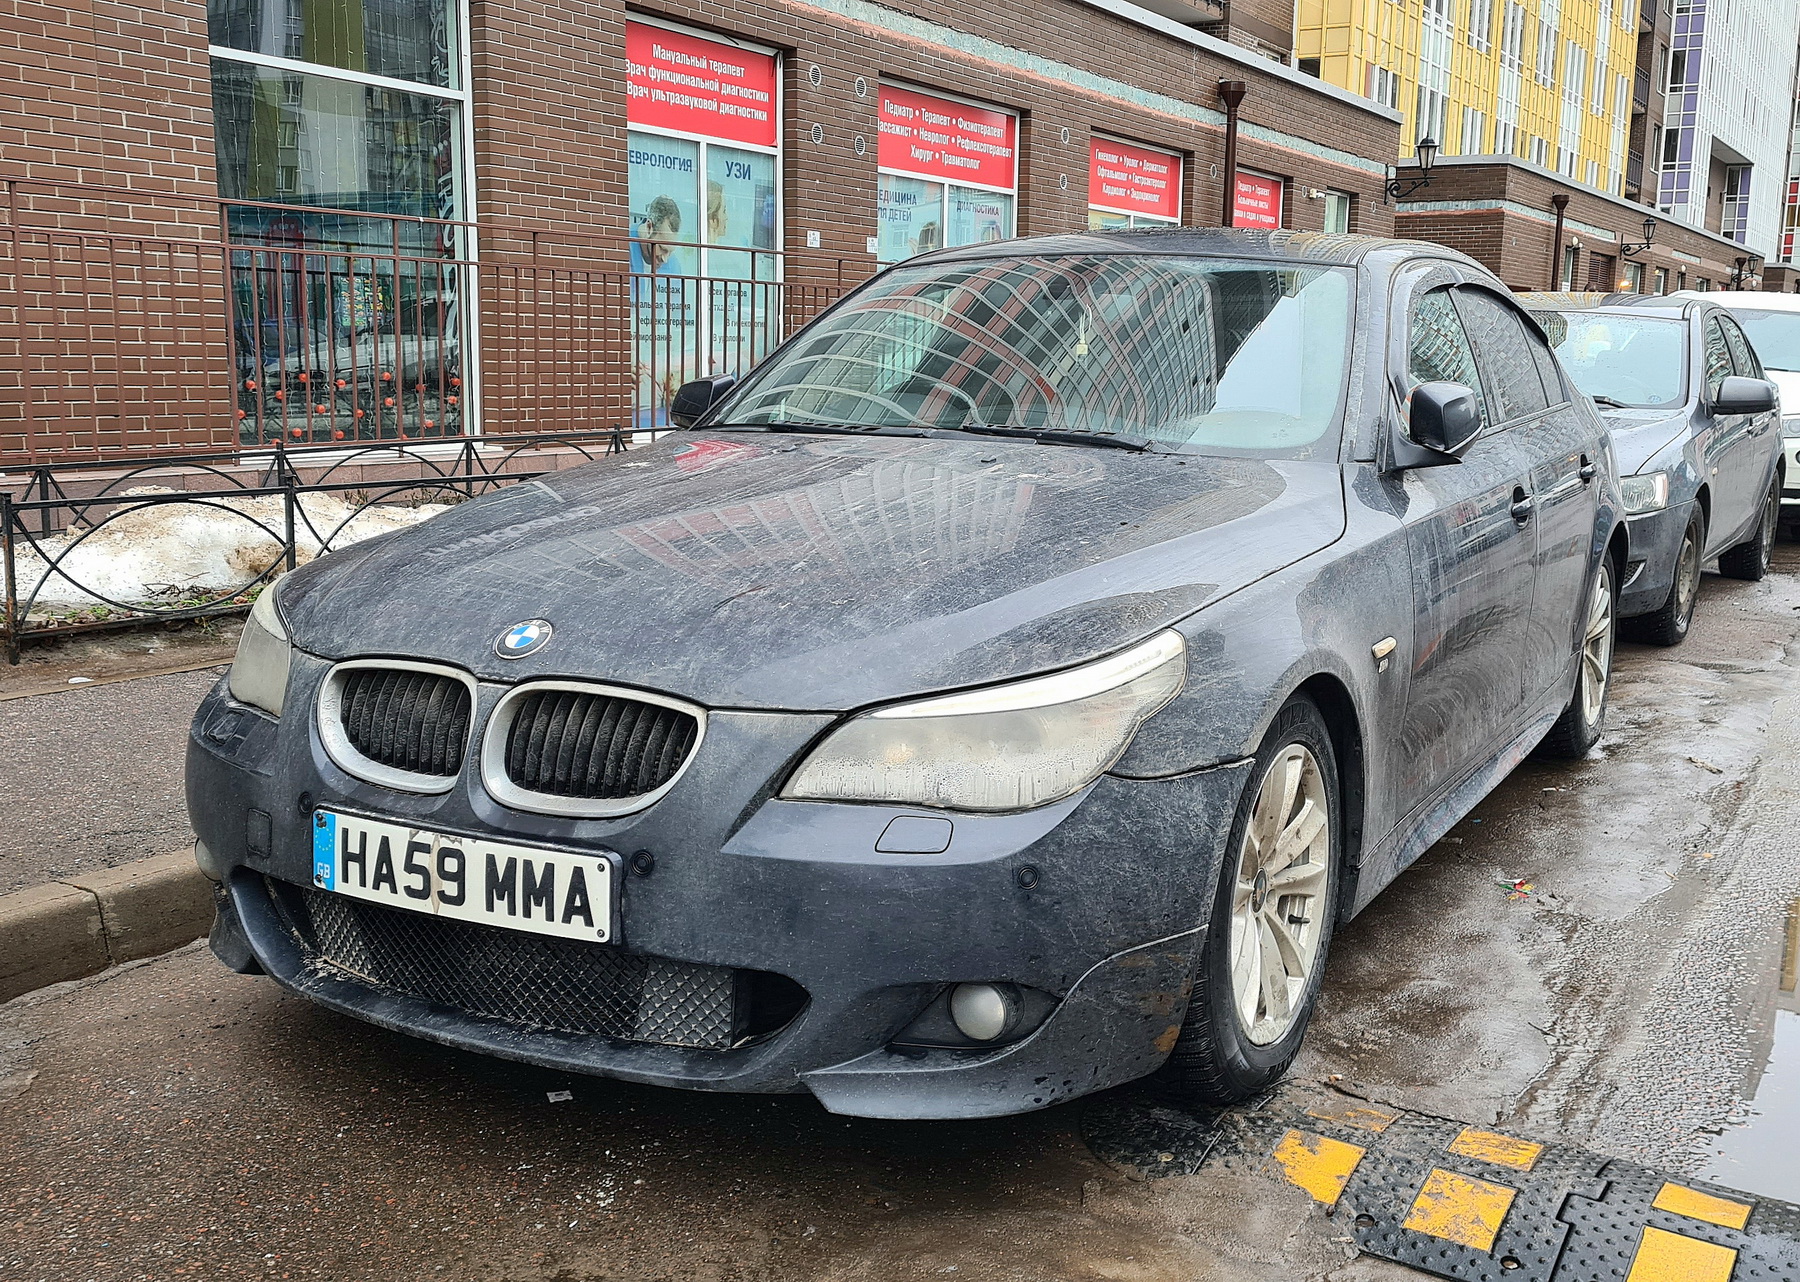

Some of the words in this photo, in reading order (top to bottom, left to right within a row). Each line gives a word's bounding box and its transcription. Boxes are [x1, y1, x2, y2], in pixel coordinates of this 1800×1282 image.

[652, 44, 707, 70] Мануальный
[709, 58, 746, 78] терапевт
[648, 64, 720, 92] функциональной
[721, 82, 769, 103] диагностики
[626, 80, 649, 99] Врач
[650, 89, 718, 112] ультразвуковой
[720, 102, 768, 122] диагностики
[884, 98, 914, 120] Педиатр
[921, 108, 950, 126] Терапевт
[957, 116, 1004, 138] Физиотерапевт
[878, 117, 912, 138] ассажист
[919, 126, 950, 146] Невролог
[956, 135, 1012, 158] Рефлексотерапевт
[726, 160, 751, 180] УЗИ
[910, 144, 934, 163] Хирург
[940, 150, 981, 170] Травматолог
[879, 189, 917, 206] ЕДИЦИНА
[956, 200, 1000, 216] ДИАГНОСТИКА
[888, 208, 912, 222] ДЕТЕЙ
[316, 862, 330, 879] GB
[341, 827, 466, 906] HA59
[485, 853, 594, 928] MMA
